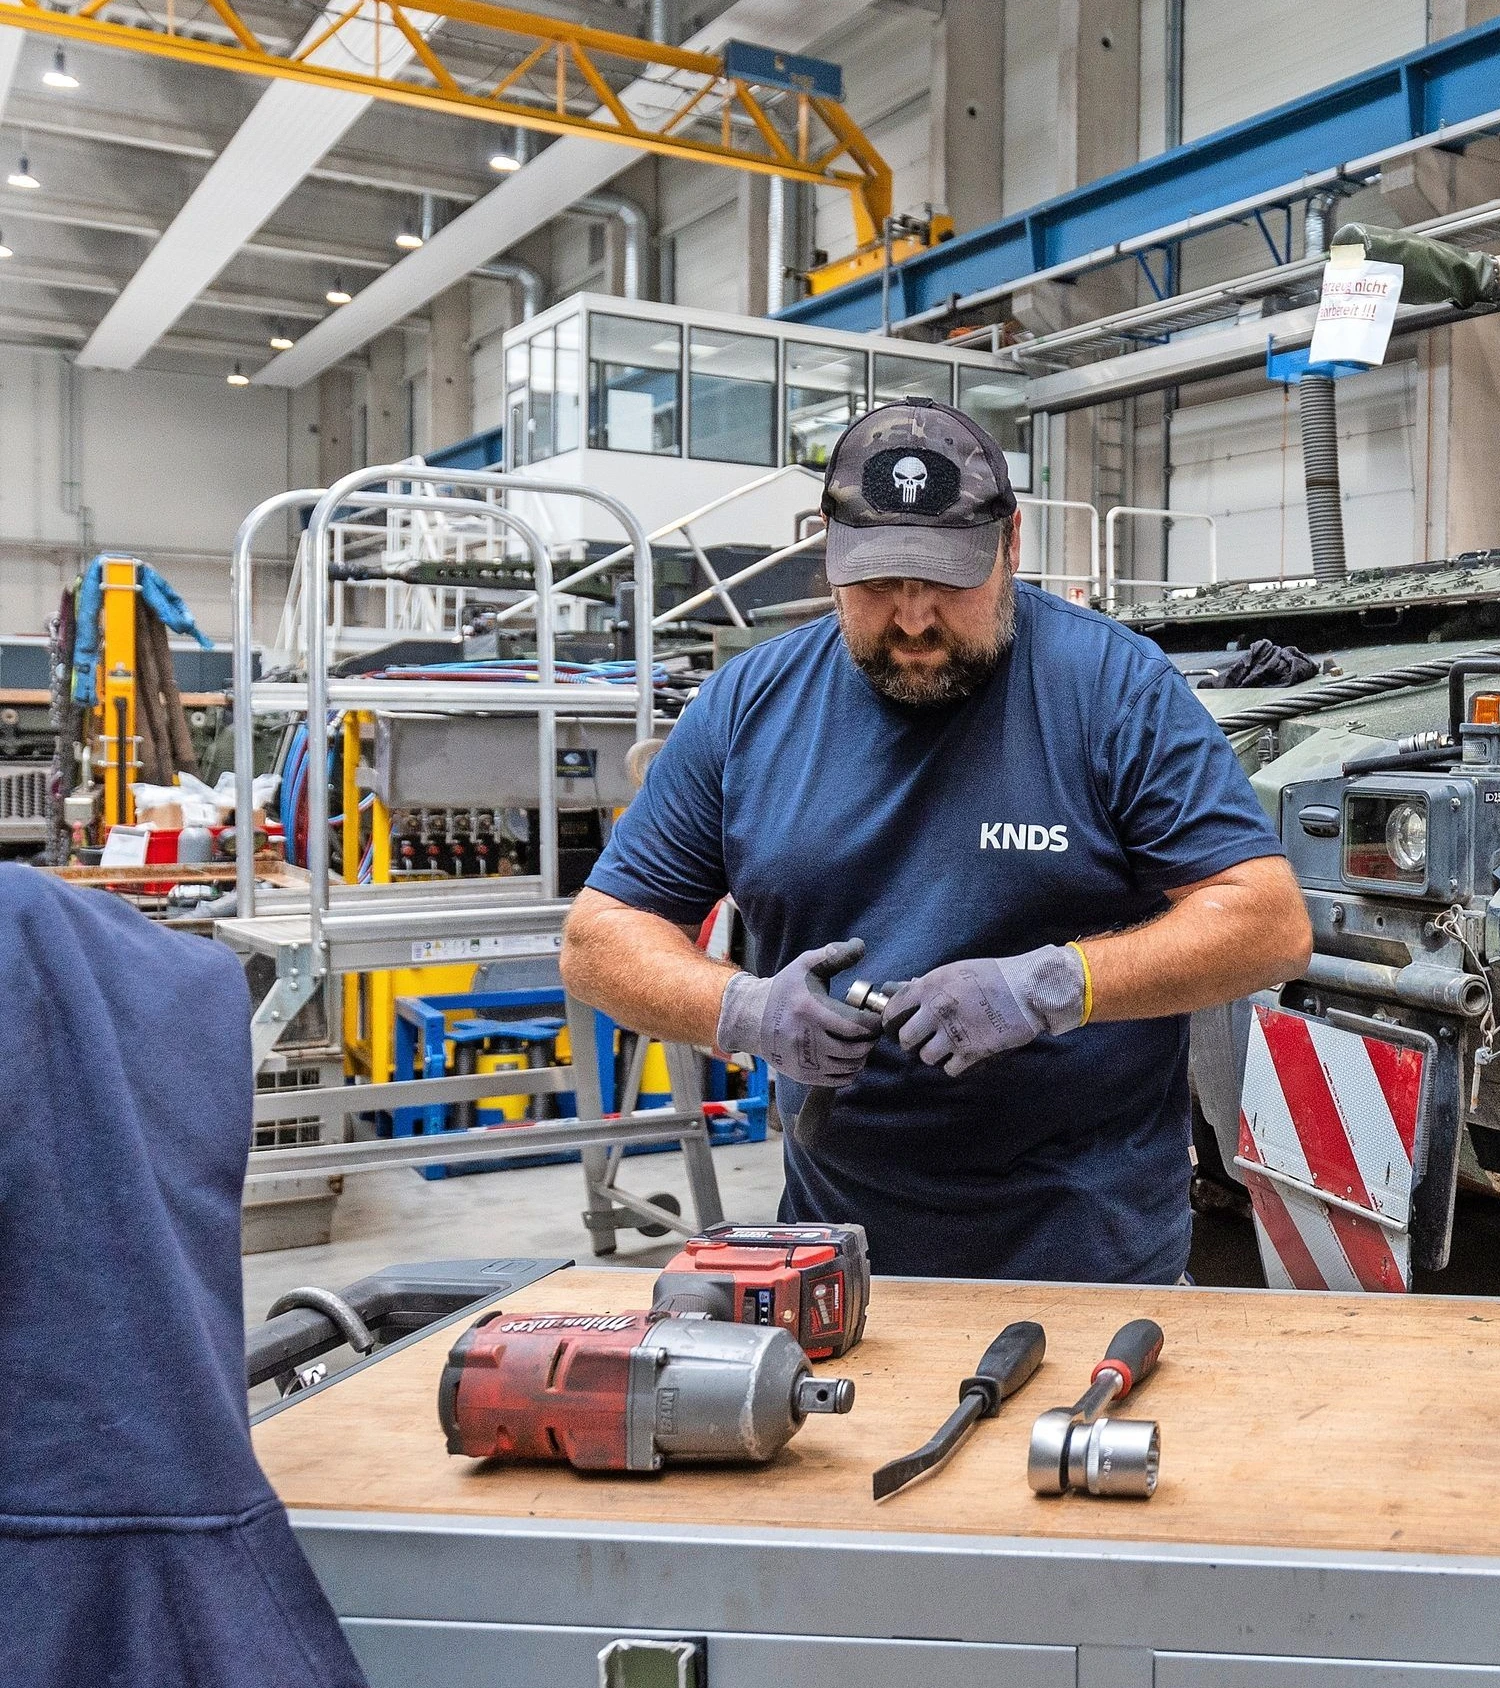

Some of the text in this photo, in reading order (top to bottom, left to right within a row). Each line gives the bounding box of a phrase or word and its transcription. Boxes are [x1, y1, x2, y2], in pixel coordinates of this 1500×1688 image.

[1355, 278, 1388, 294] nicht
[980, 823, 1069, 852] KNDS
[979, 999, 1004, 1034] NITRILE
[501, 1315, 638, 1334] Milwukee
